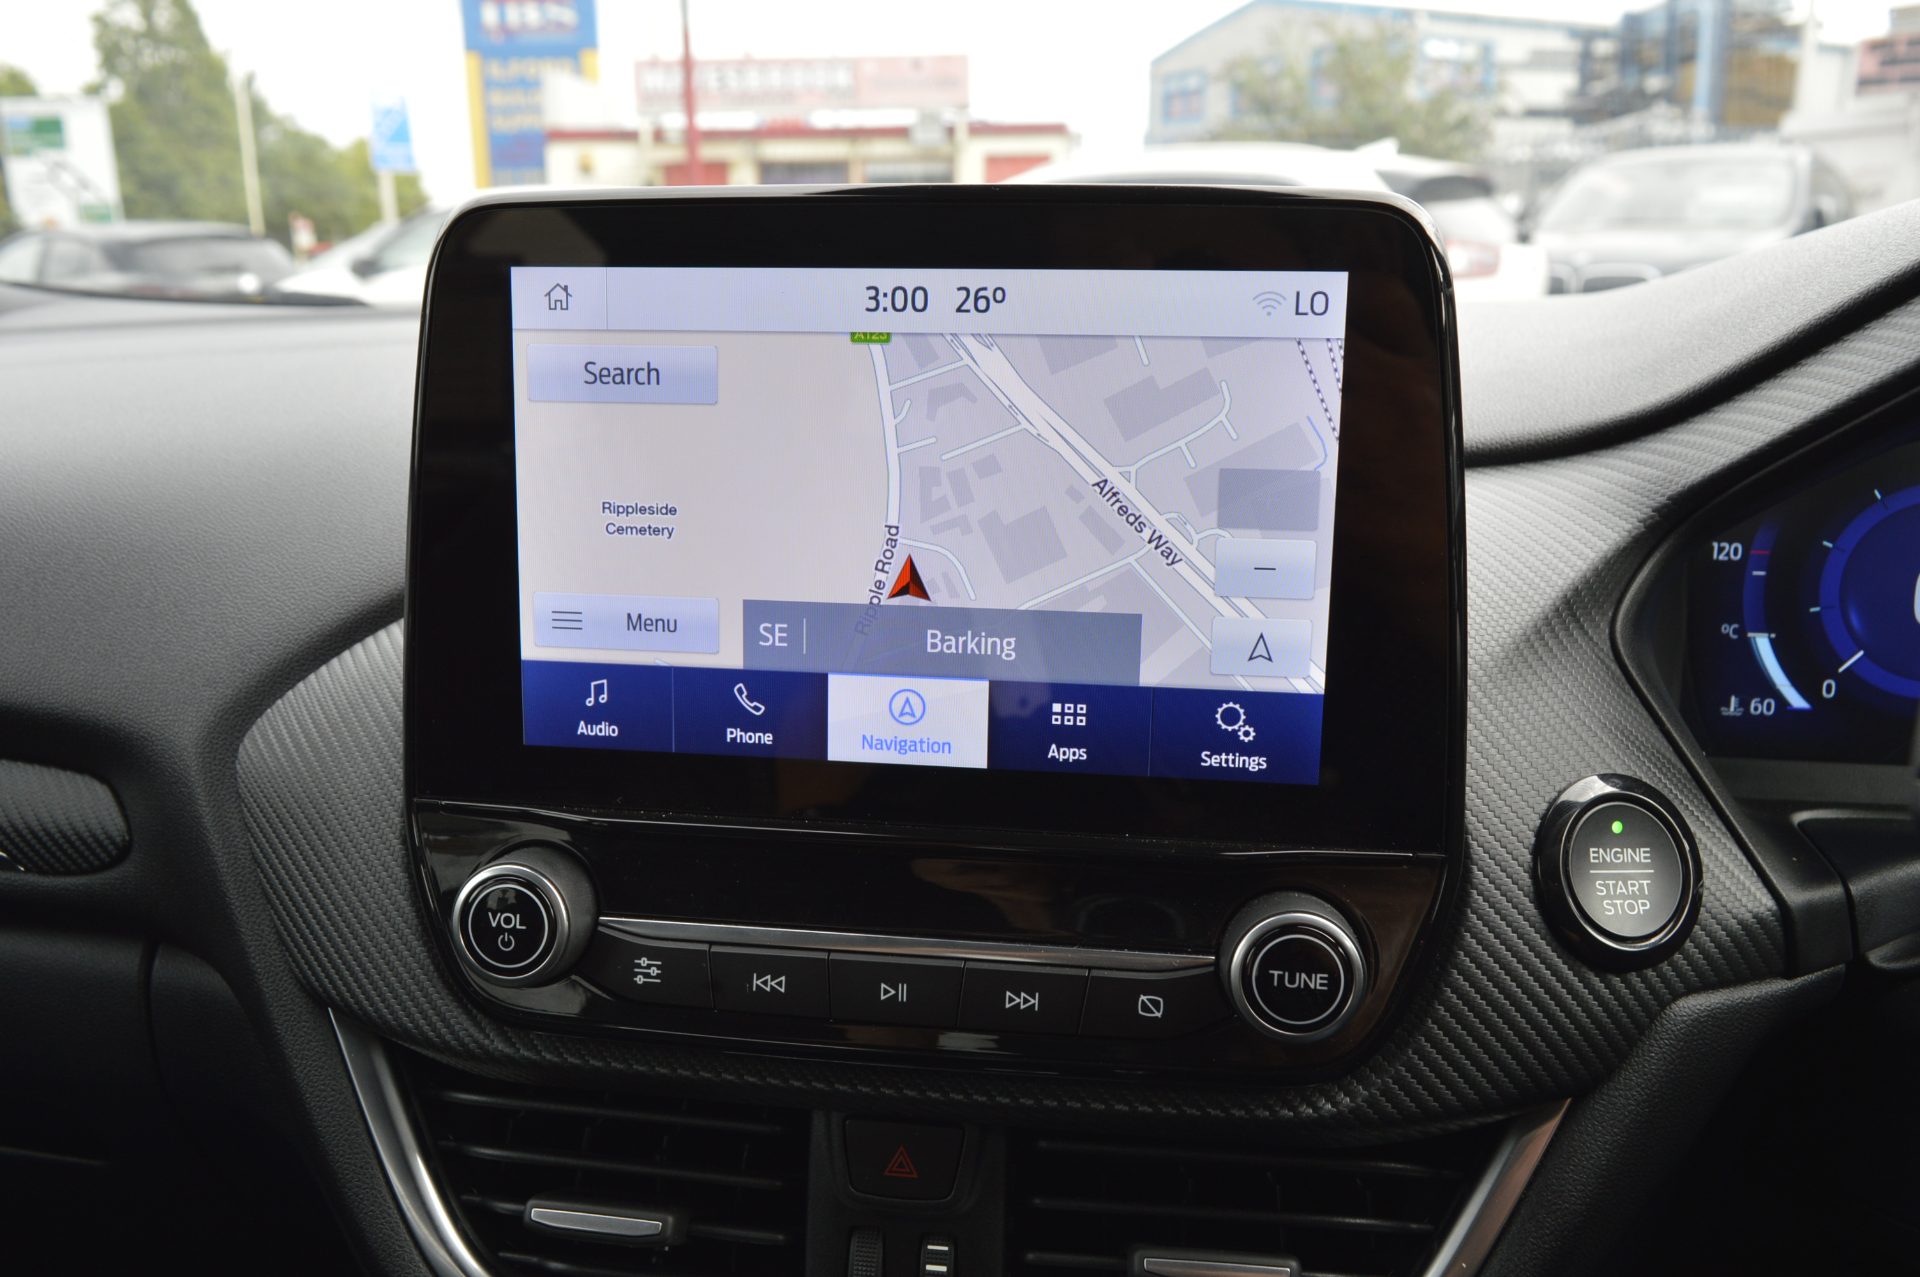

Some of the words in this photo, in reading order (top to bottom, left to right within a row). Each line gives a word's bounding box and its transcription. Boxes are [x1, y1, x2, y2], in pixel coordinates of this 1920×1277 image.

[864, 285, 930, 314] 3:00
[1294, 290, 1330, 316] LO
[583, 361, 661, 386] Search
[601, 501, 677, 518] Rippleside
[605, 522, 675, 540] Cemetery
[1091, 478, 1147, 534] Alfreds
[1147, 529, 1183, 566] Way
[1712, 542, 1743, 561] 120
[854, 579, 886, 636] Ripple
[874, 524, 899, 574] Road
[625, 612, 678, 634] Menu
[758, 623, 789, 647] SE
[926, 629, 1017, 660] Barking
[1822, 679, 1836, 698] 0
[1750, 698, 1775, 716] 60
[577, 720, 619, 738] Audio
[726, 727, 774, 746] Phone
[861, 734, 952, 755] Navigation
[1047, 743, 1088, 762] Apps
[1200, 750, 1268, 772] Settings
[1589, 847, 1652, 863] ENGINE
[1595, 880, 1652, 896] START
[1602, 899, 1651, 916] STOP
[488, 911, 528, 930] VOL
[1268, 969, 1329, 991] TUNE
